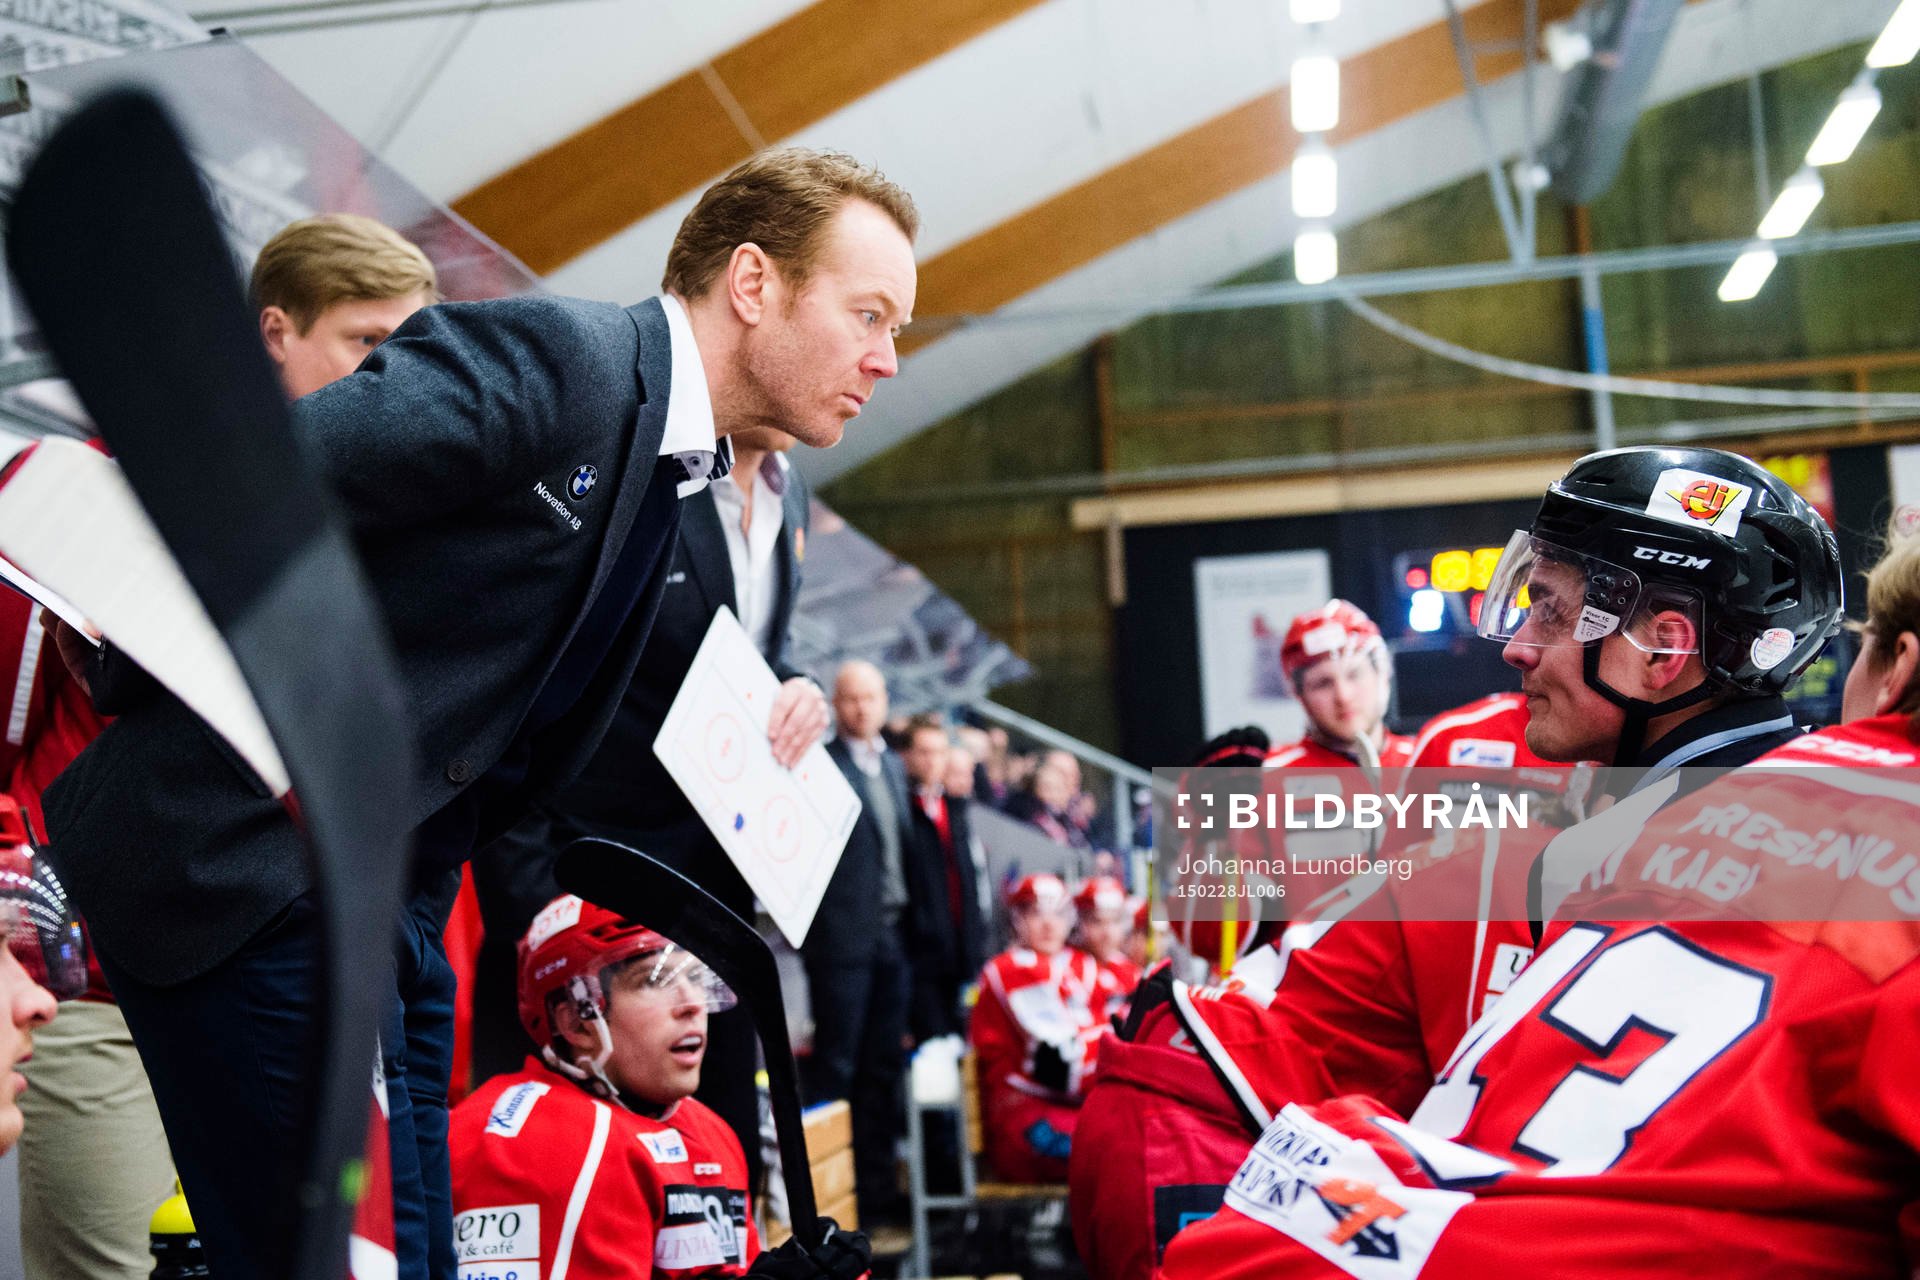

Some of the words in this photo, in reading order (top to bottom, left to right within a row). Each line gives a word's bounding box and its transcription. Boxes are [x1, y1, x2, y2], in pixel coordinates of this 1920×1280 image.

[533, 481, 572, 520] Novation
[569, 515, 582, 530] AB
[1632, 546, 1712, 569] CCM
[483, 1240, 514, 1255] café
